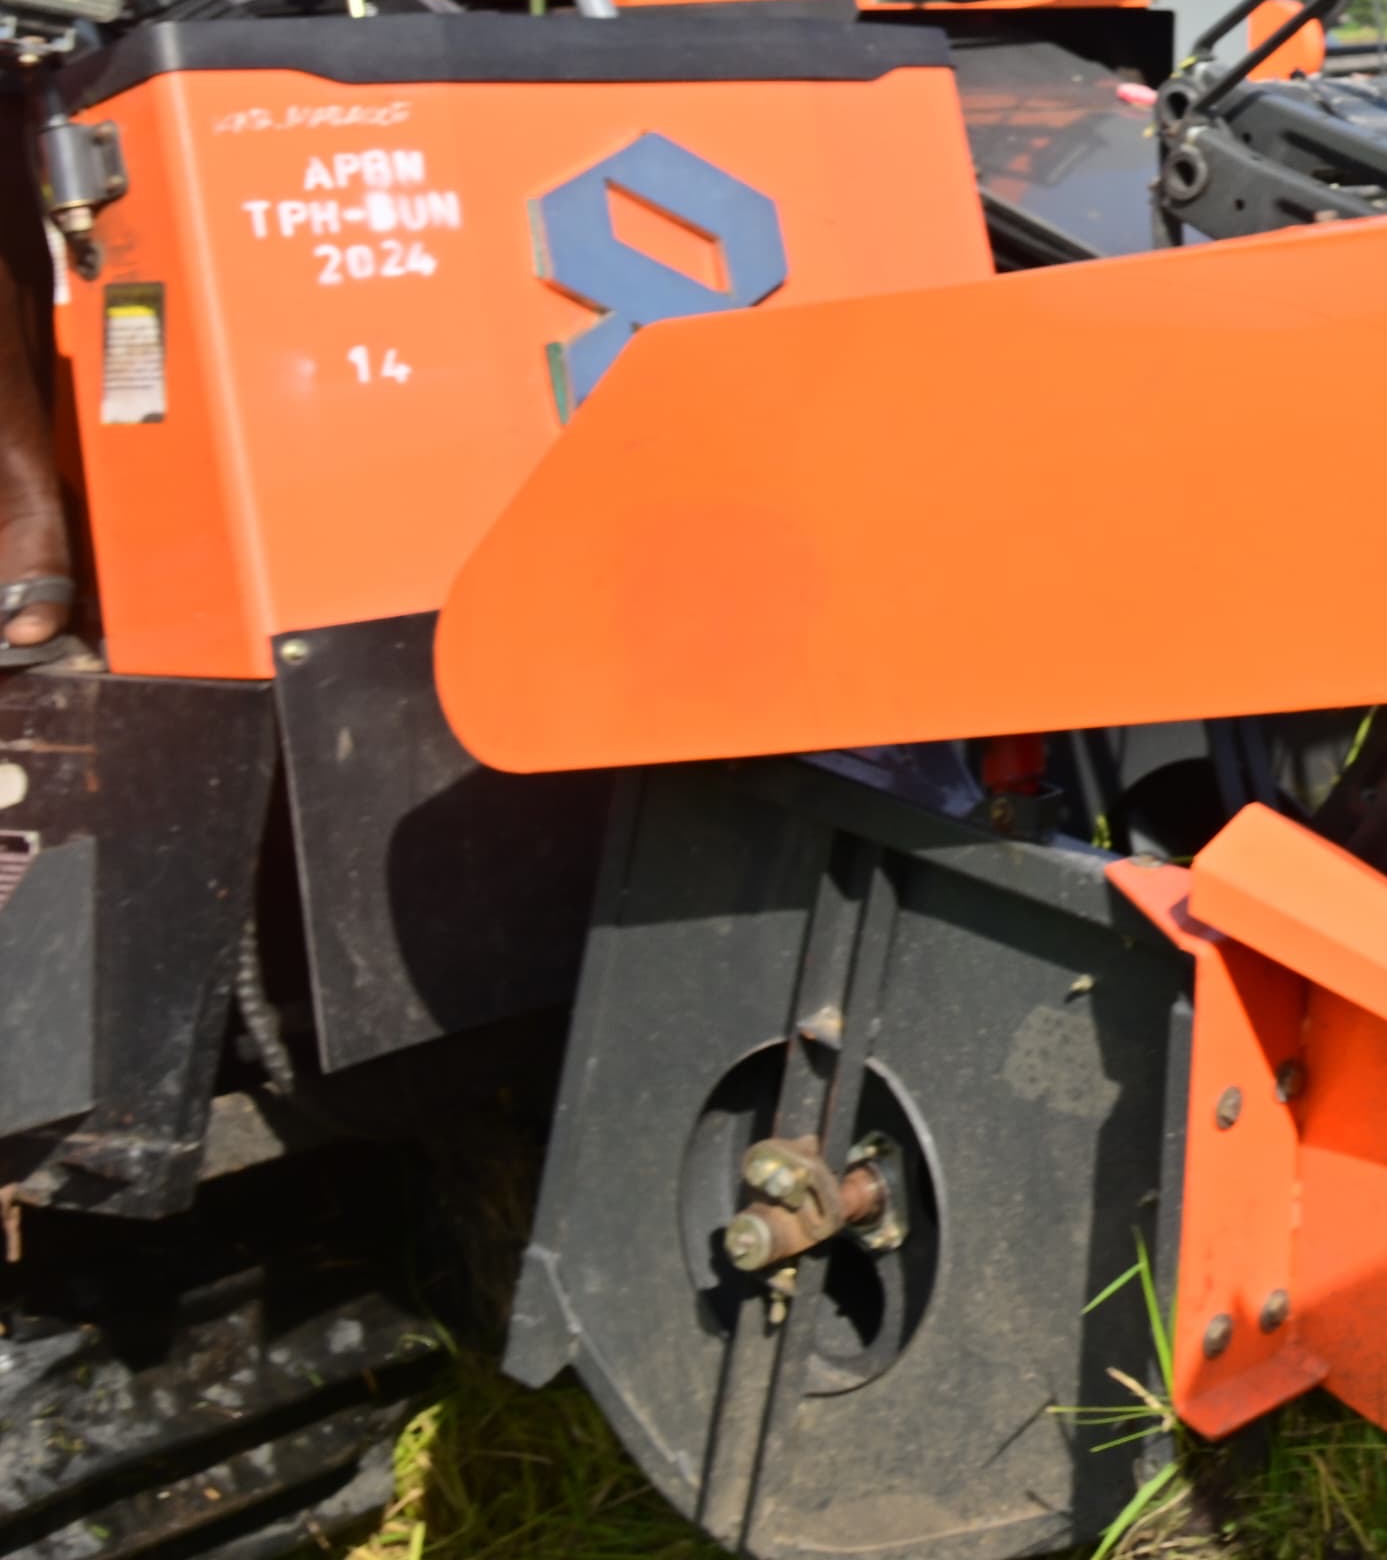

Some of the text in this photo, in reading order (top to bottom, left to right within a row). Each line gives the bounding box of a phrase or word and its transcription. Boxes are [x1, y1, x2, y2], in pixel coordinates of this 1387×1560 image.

[303, 149, 425, 190] APBN
[314, 239, 437, 285] 2024
[348, 344, 412, 384] 14
